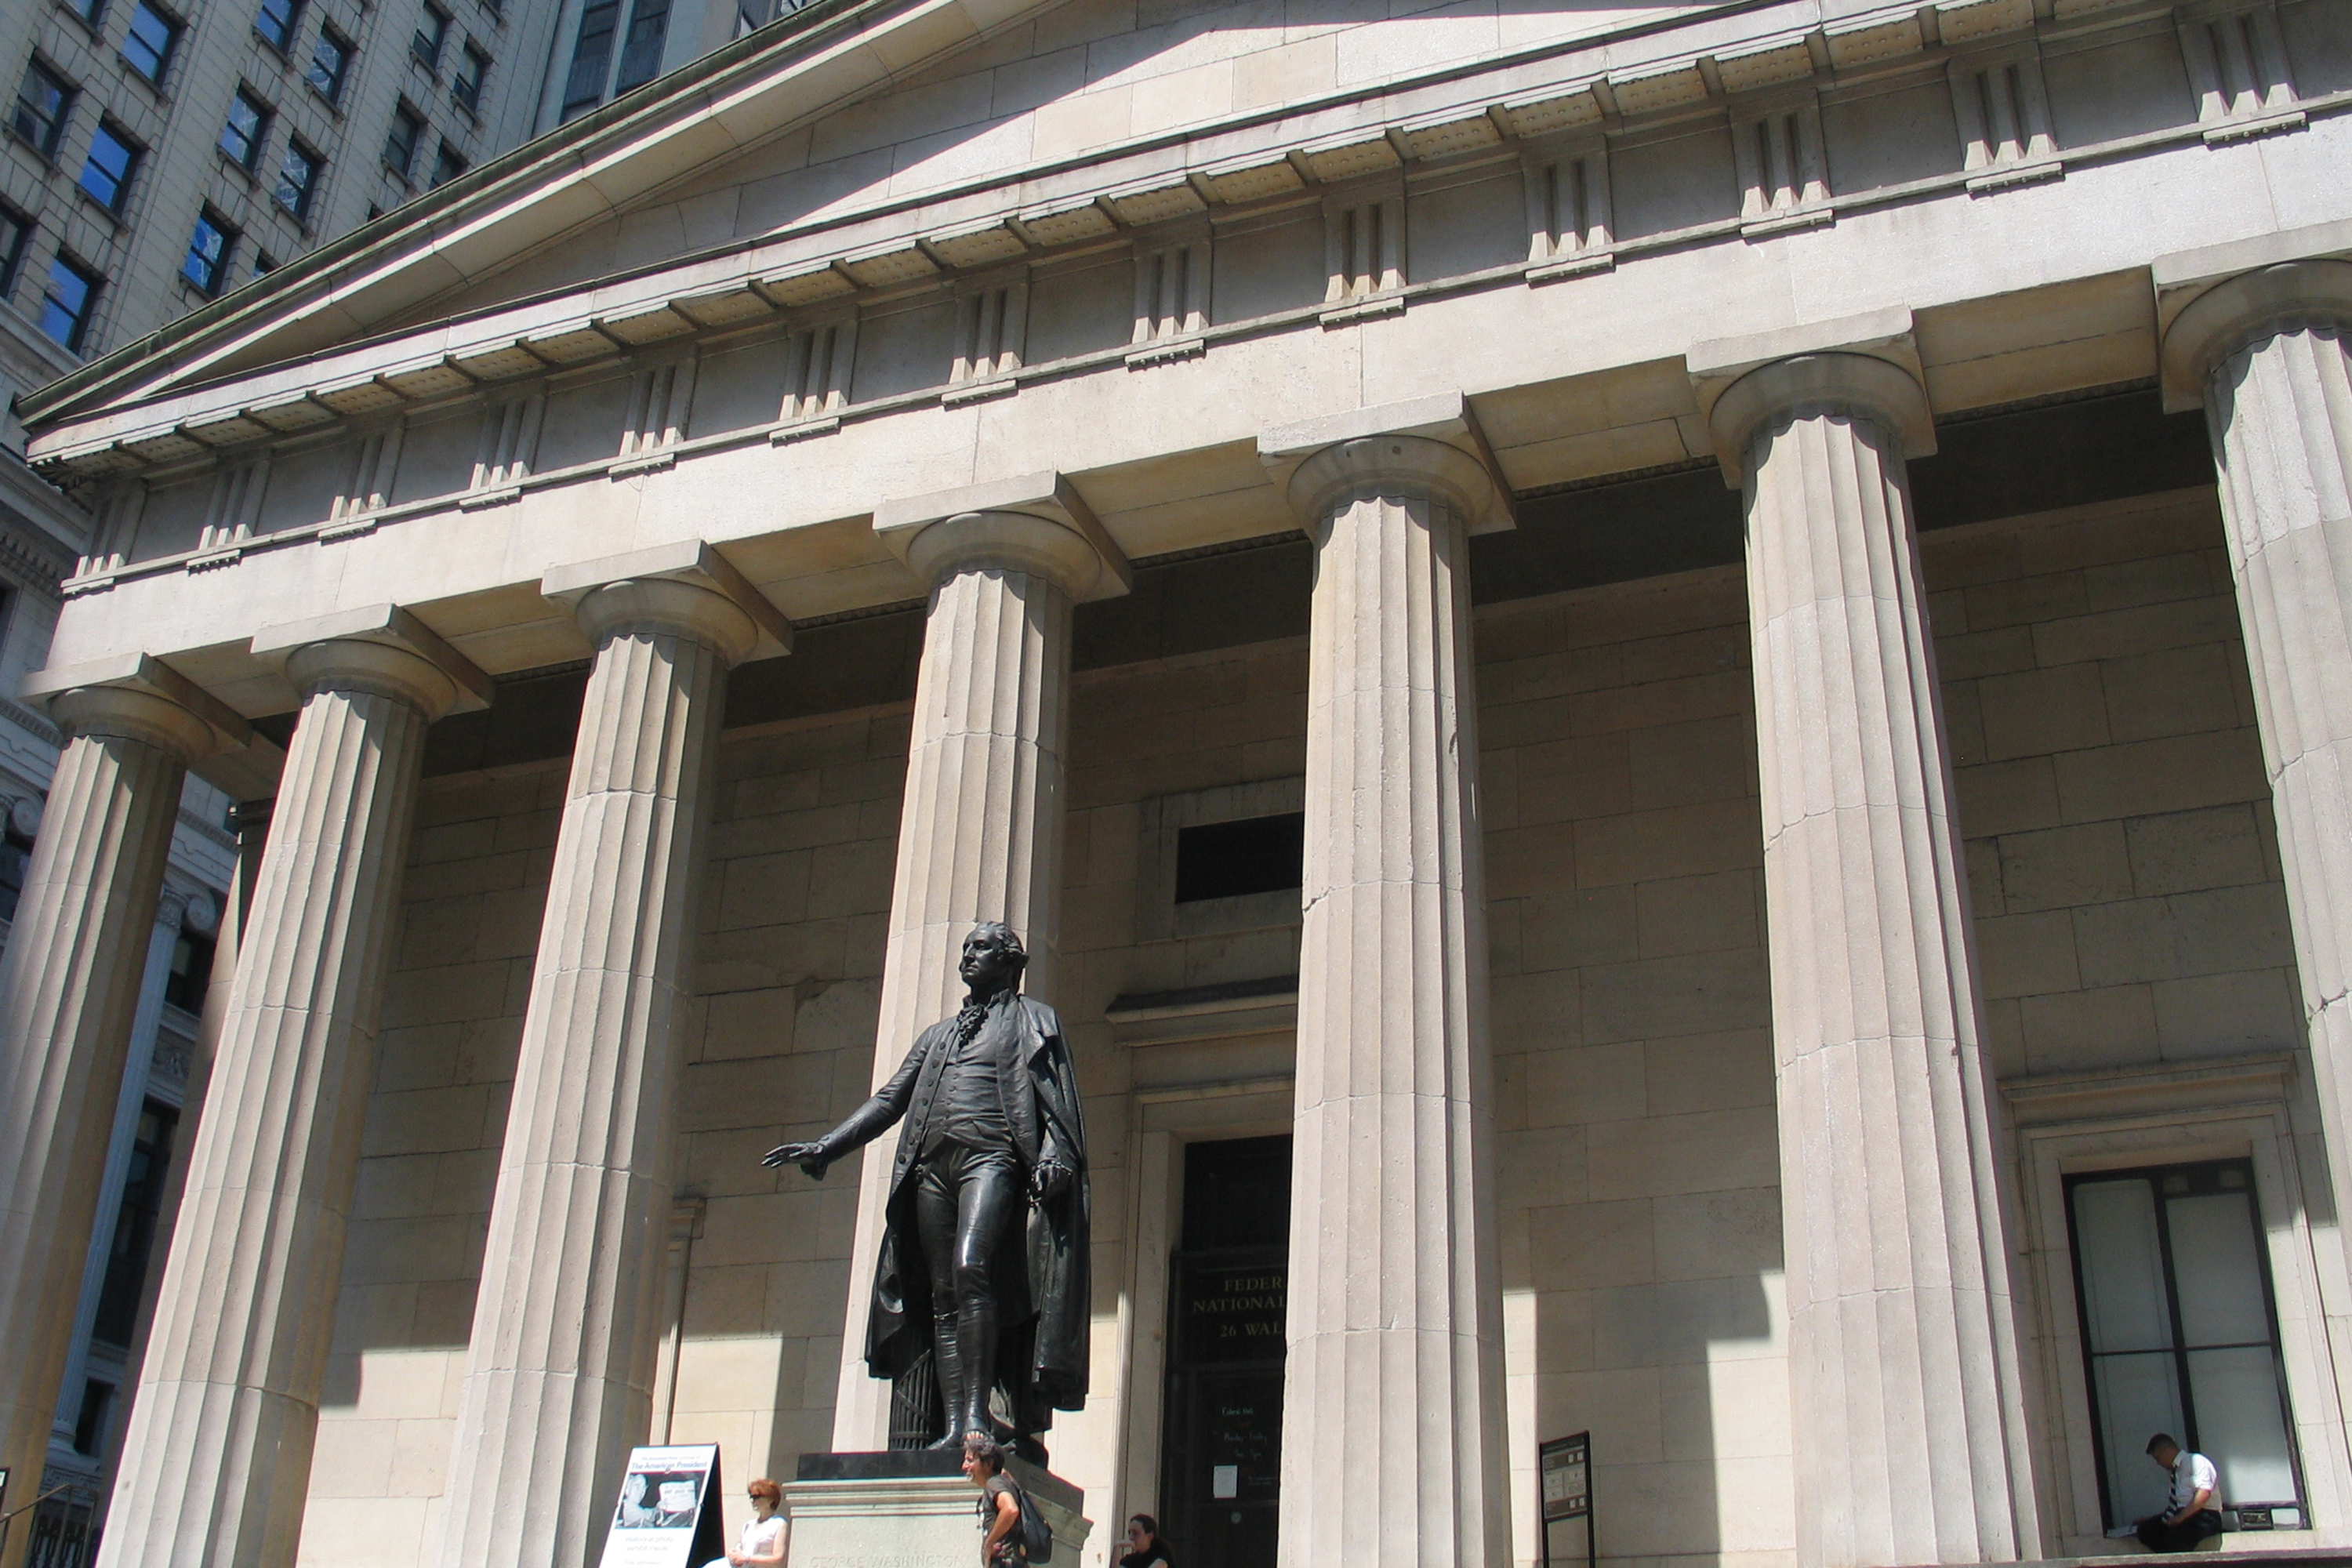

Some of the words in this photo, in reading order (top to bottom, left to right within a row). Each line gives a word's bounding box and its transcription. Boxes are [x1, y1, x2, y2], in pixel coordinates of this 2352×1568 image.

[1224, 1276, 1283, 1292] FEDER
[1220, 1325, 1236, 1338] 26
[810, 1555, 865, 1568] GEORGE
